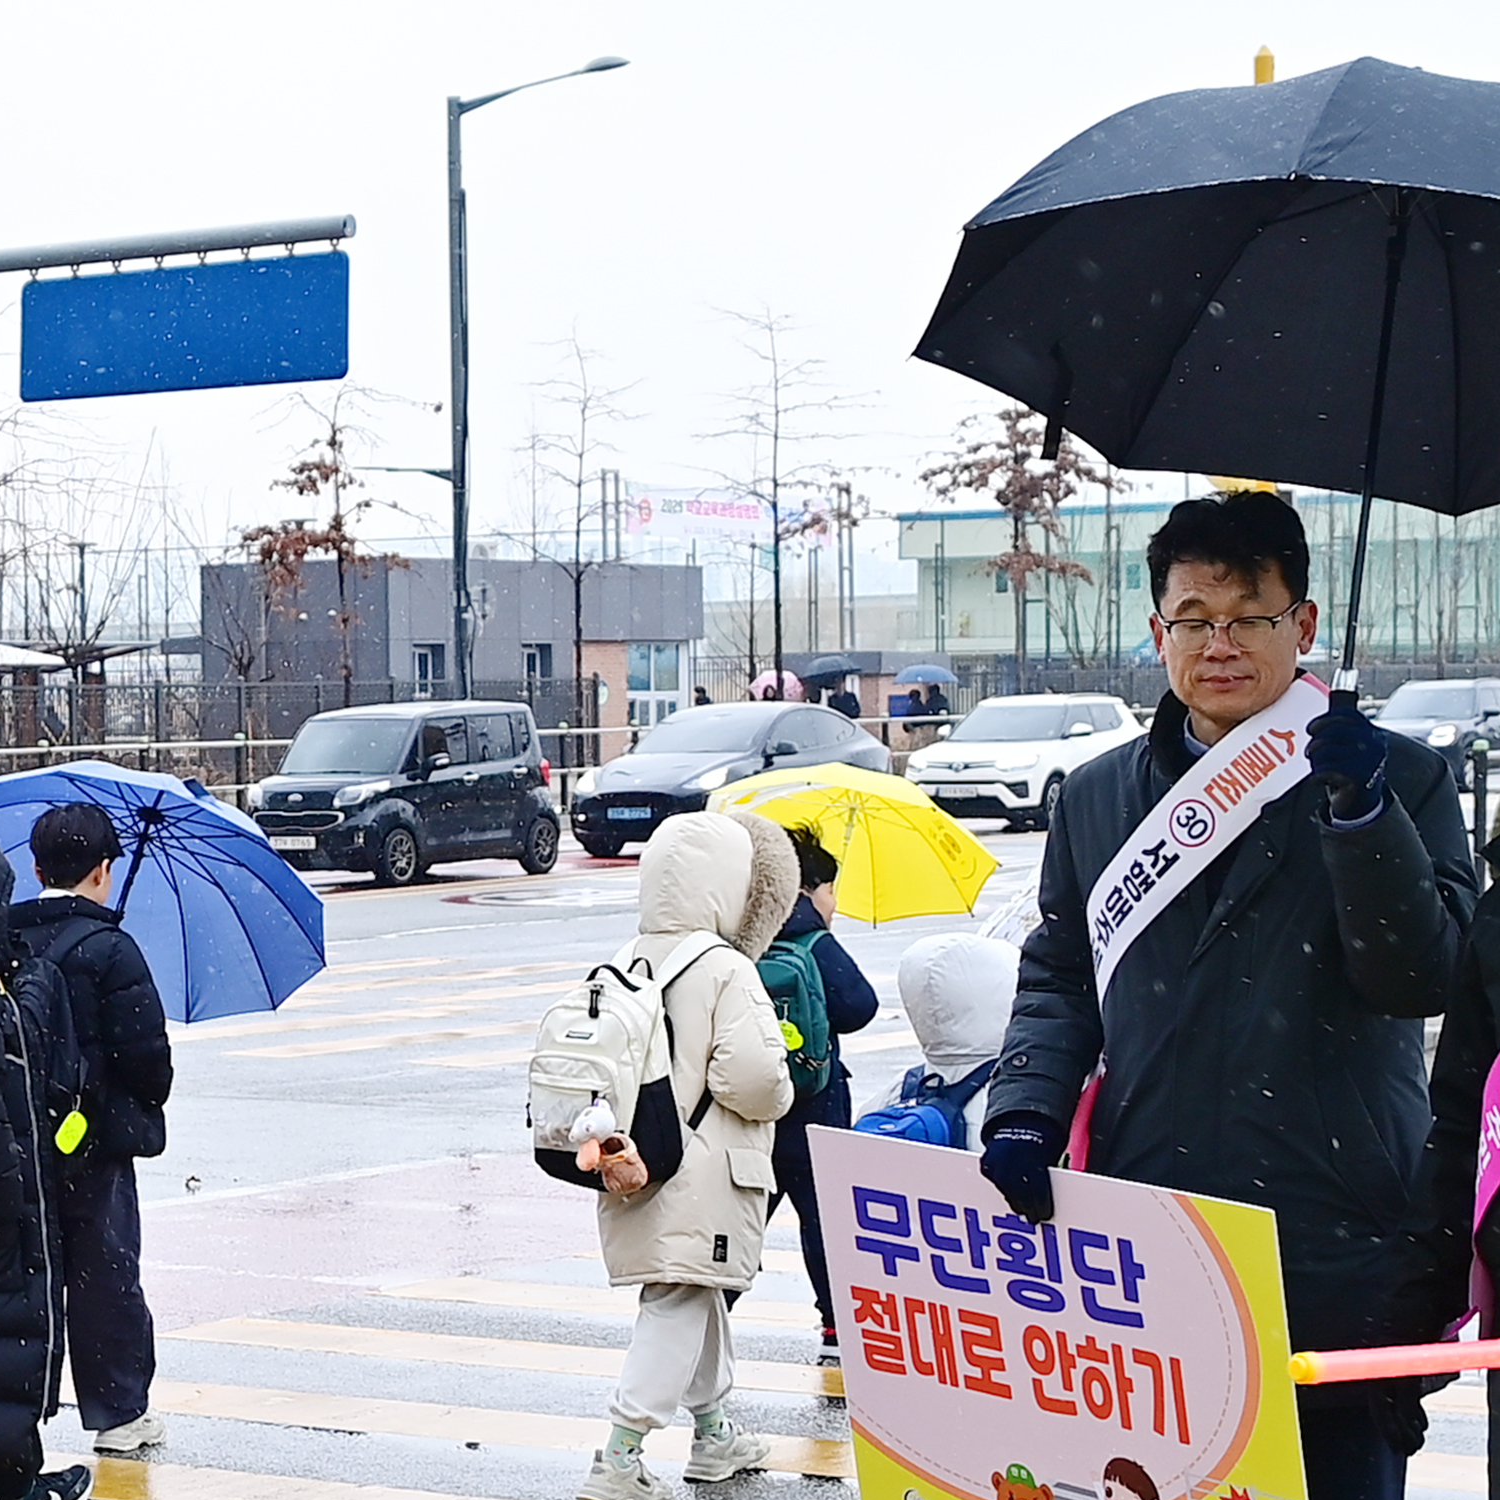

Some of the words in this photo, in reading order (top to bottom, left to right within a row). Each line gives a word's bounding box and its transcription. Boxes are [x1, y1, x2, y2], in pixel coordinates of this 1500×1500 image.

[1175, 805, 1209, 840] 30
[1203, 727, 1297, 814] 스쿨존
[851, 1185, 1146, 1329] 무단횡단
[850, 1284, 1013, 1401] 절대로
[1022, 1324, 1191, 1446] 안하기
